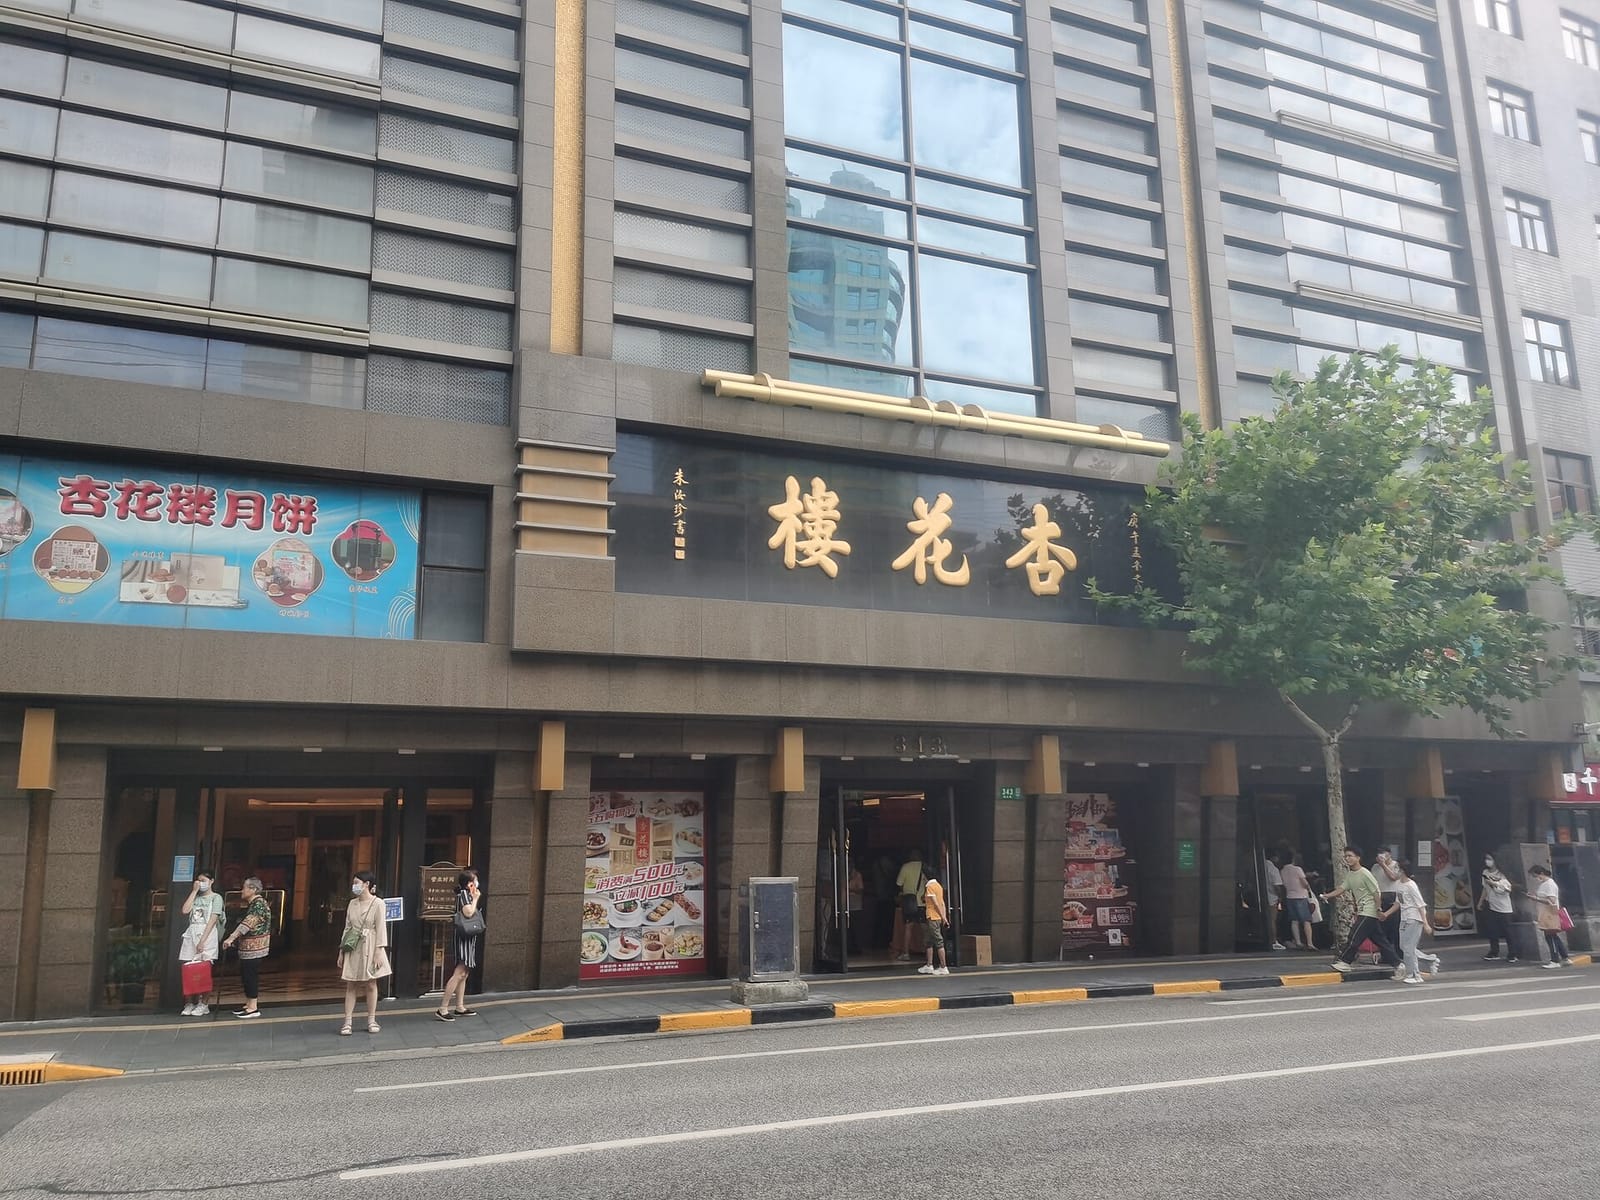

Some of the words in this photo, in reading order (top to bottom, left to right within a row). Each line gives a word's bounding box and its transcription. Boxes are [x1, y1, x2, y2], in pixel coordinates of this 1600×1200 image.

[57, 474, 319, 536] 杏花楼月饼
